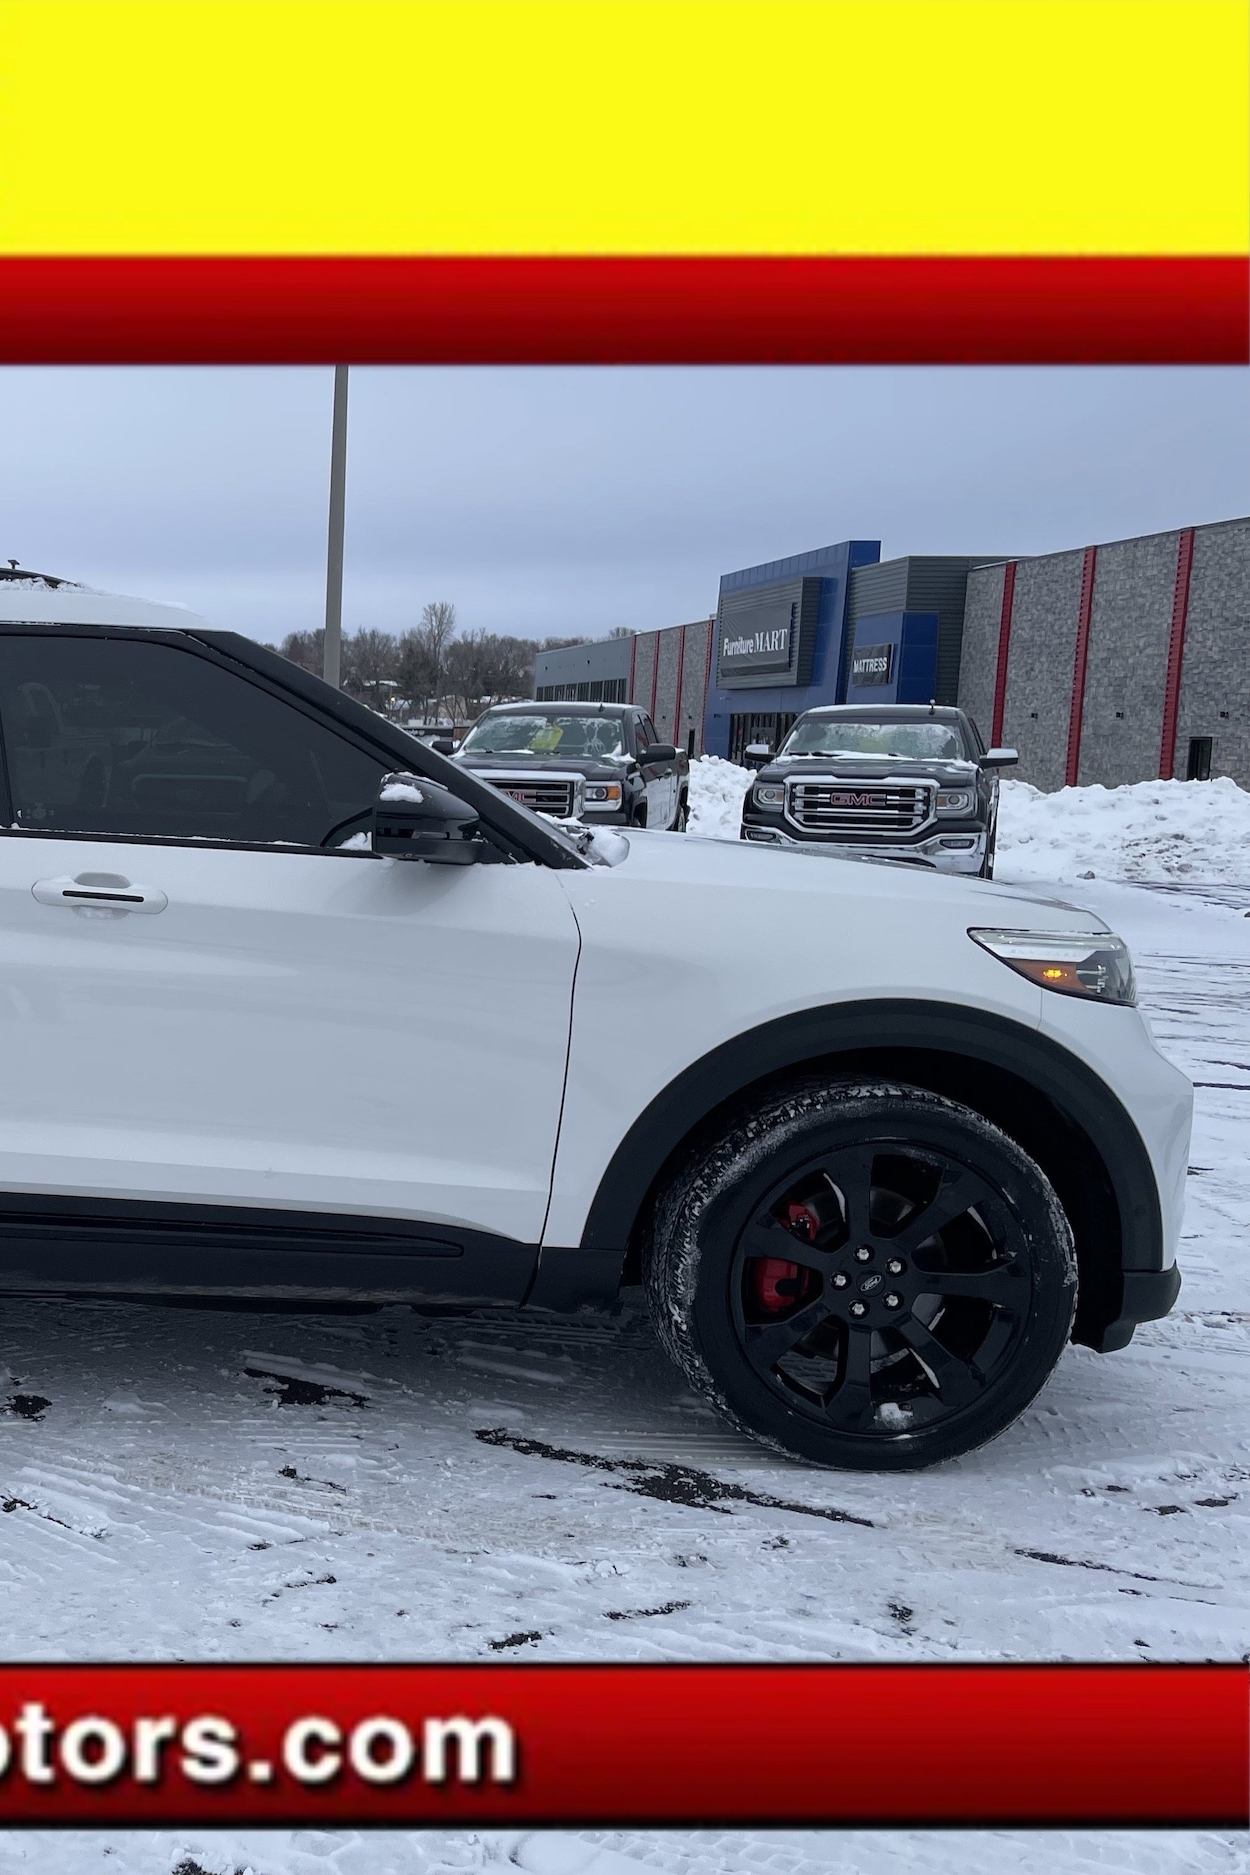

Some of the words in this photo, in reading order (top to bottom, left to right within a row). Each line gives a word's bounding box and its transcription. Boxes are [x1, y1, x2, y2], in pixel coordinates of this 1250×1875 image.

[853, 657, 887, 673] MATTRESS
[504, 790, 537, 804] MC
[831, 792, 887, 807] GMC
